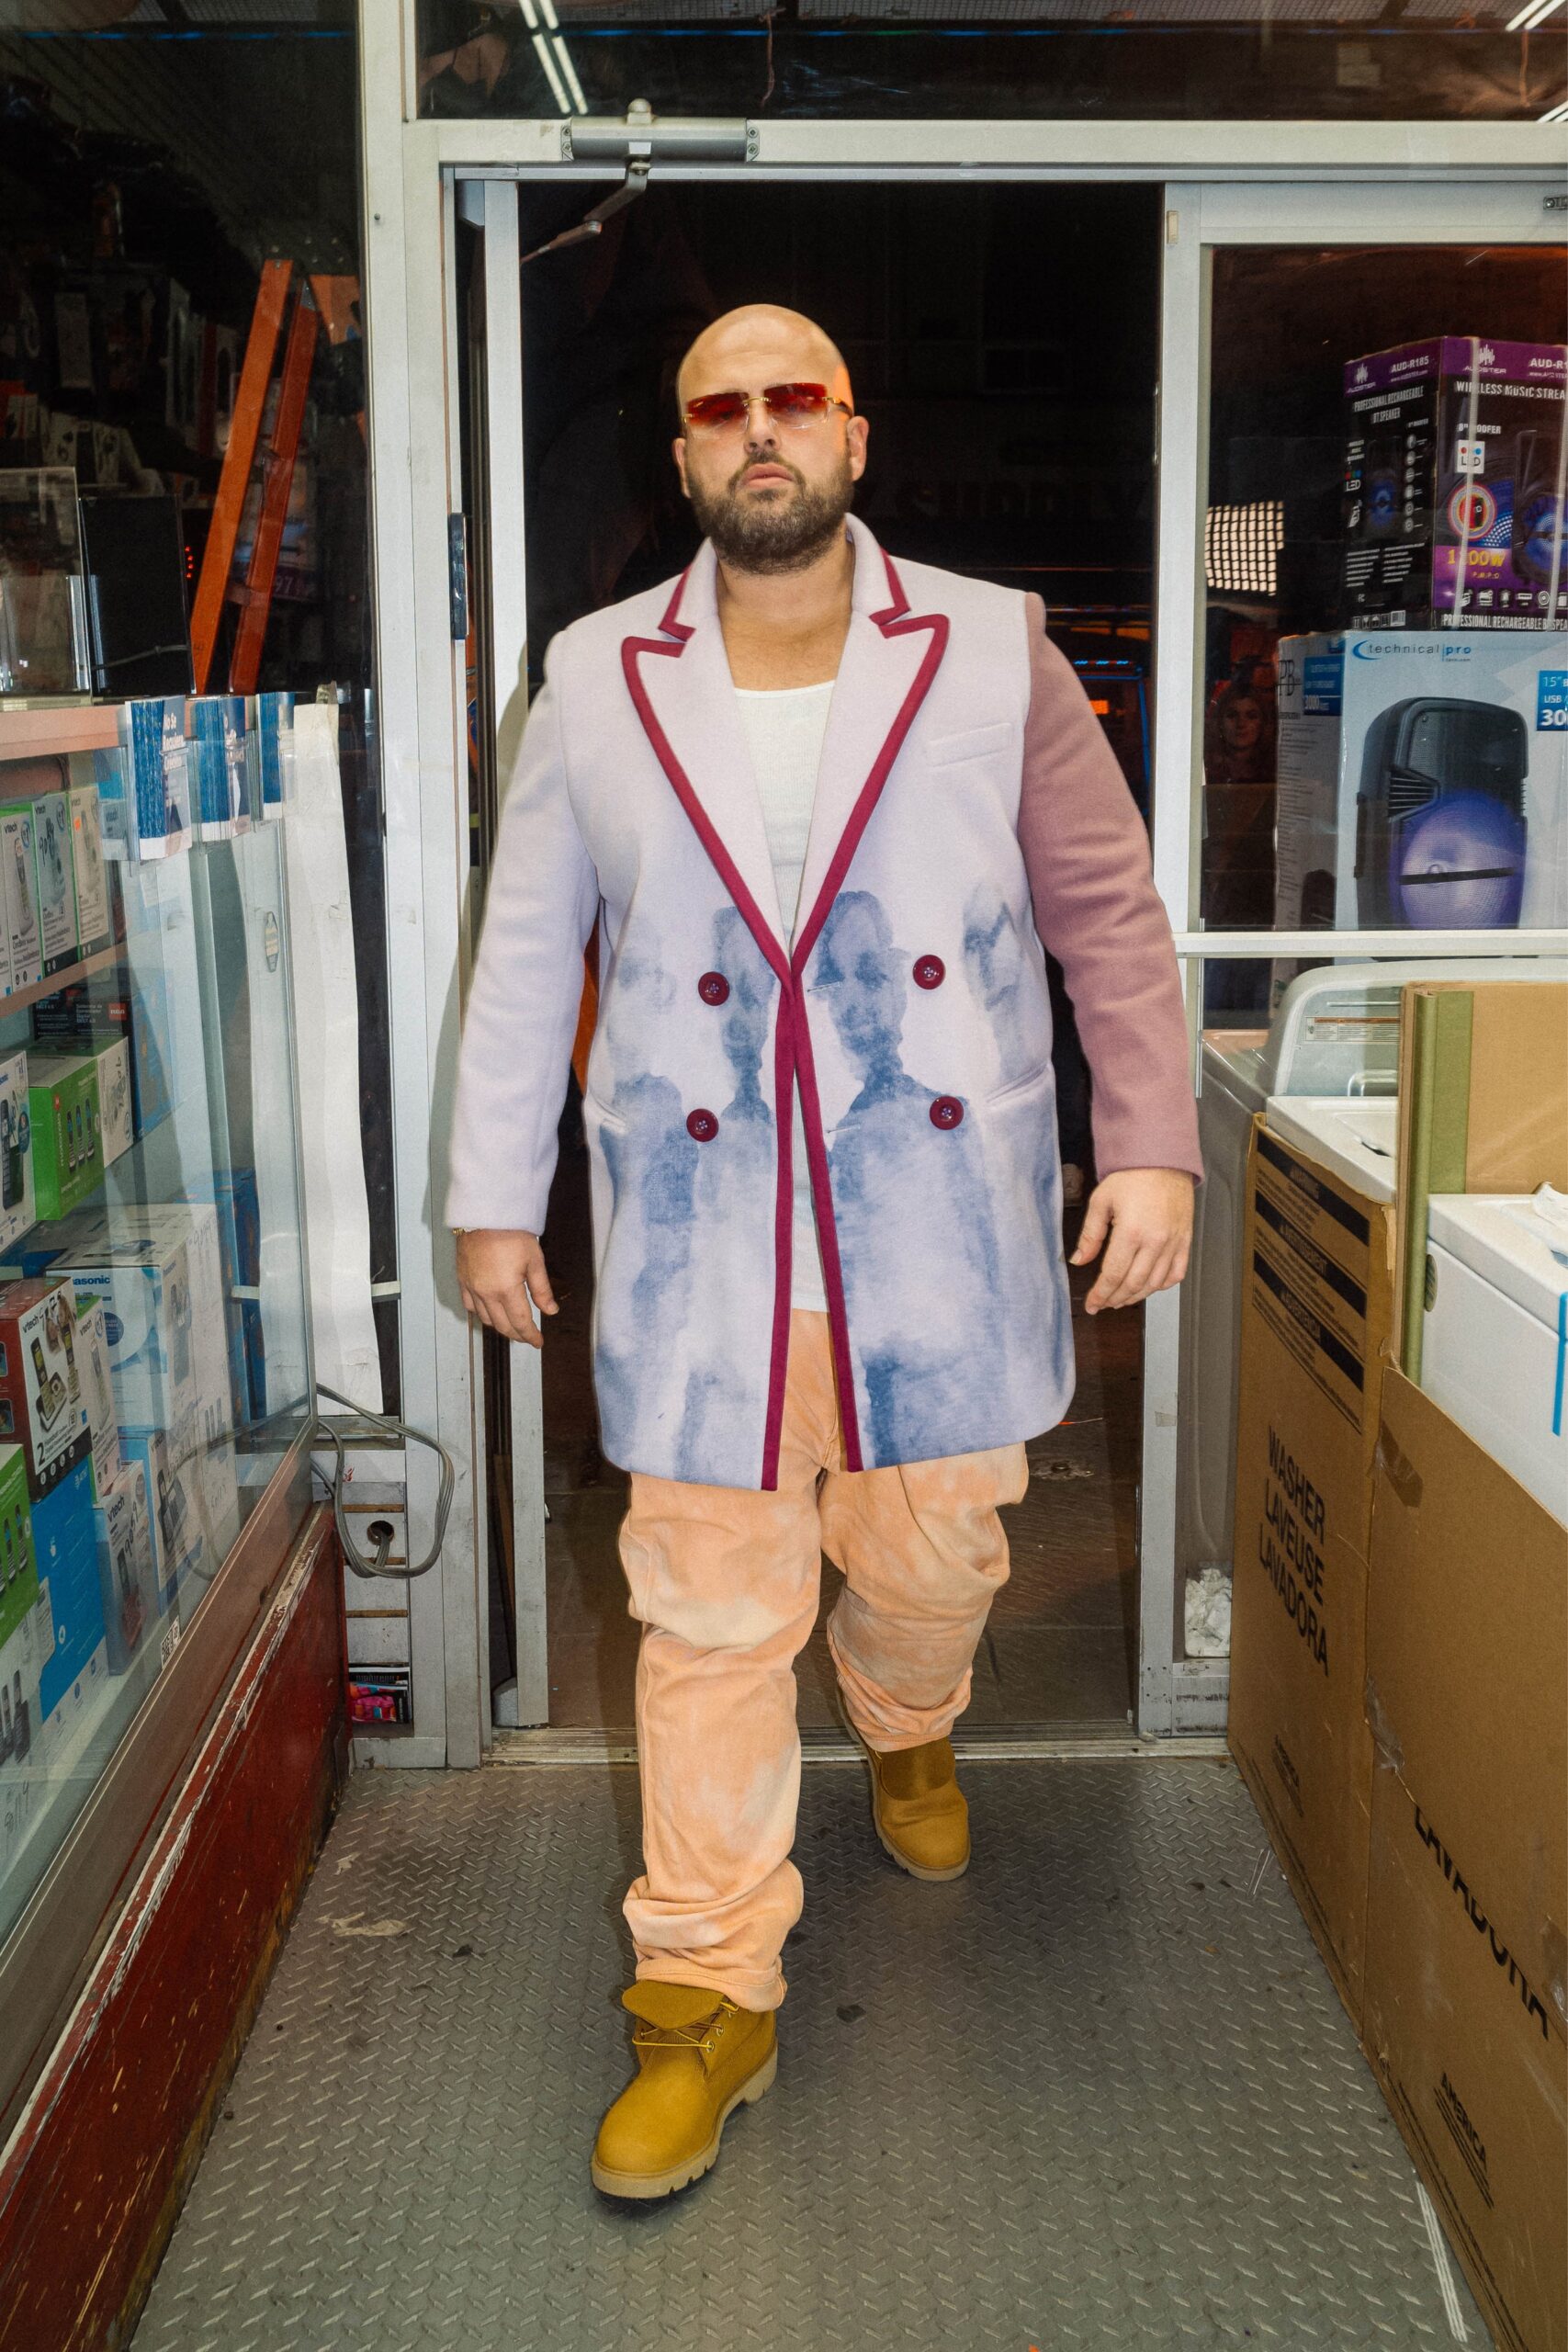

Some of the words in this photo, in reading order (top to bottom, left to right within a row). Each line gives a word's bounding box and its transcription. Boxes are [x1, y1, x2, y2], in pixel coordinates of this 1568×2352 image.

[1391, 356, 1429, 373] AUD-R185
[1455, 381, 1503, 395] WILESS
[1505, 384, 1535, 398] MUSIC
[1380, 407, 1401, 422] SPEAKER
[1475, 424, 1502, 435] OOFER
[1461, 456, 1481, 467] LD
[1443, 613, 1492, 628] PRESSIONAL
[1493, 616, 1542, 630] RECHARGEABLE
[1369, 644, 1439, 654] technical
[1446, 646, 1472, 656] pro
[1544, 695, 1562, 704] USB
[1269, 1425, 1325, 1547] WASHER
[1266, 1477, 1325, 1607] LAVEUSE
[1259, 1522, 1328, 1677] LAVADORA
